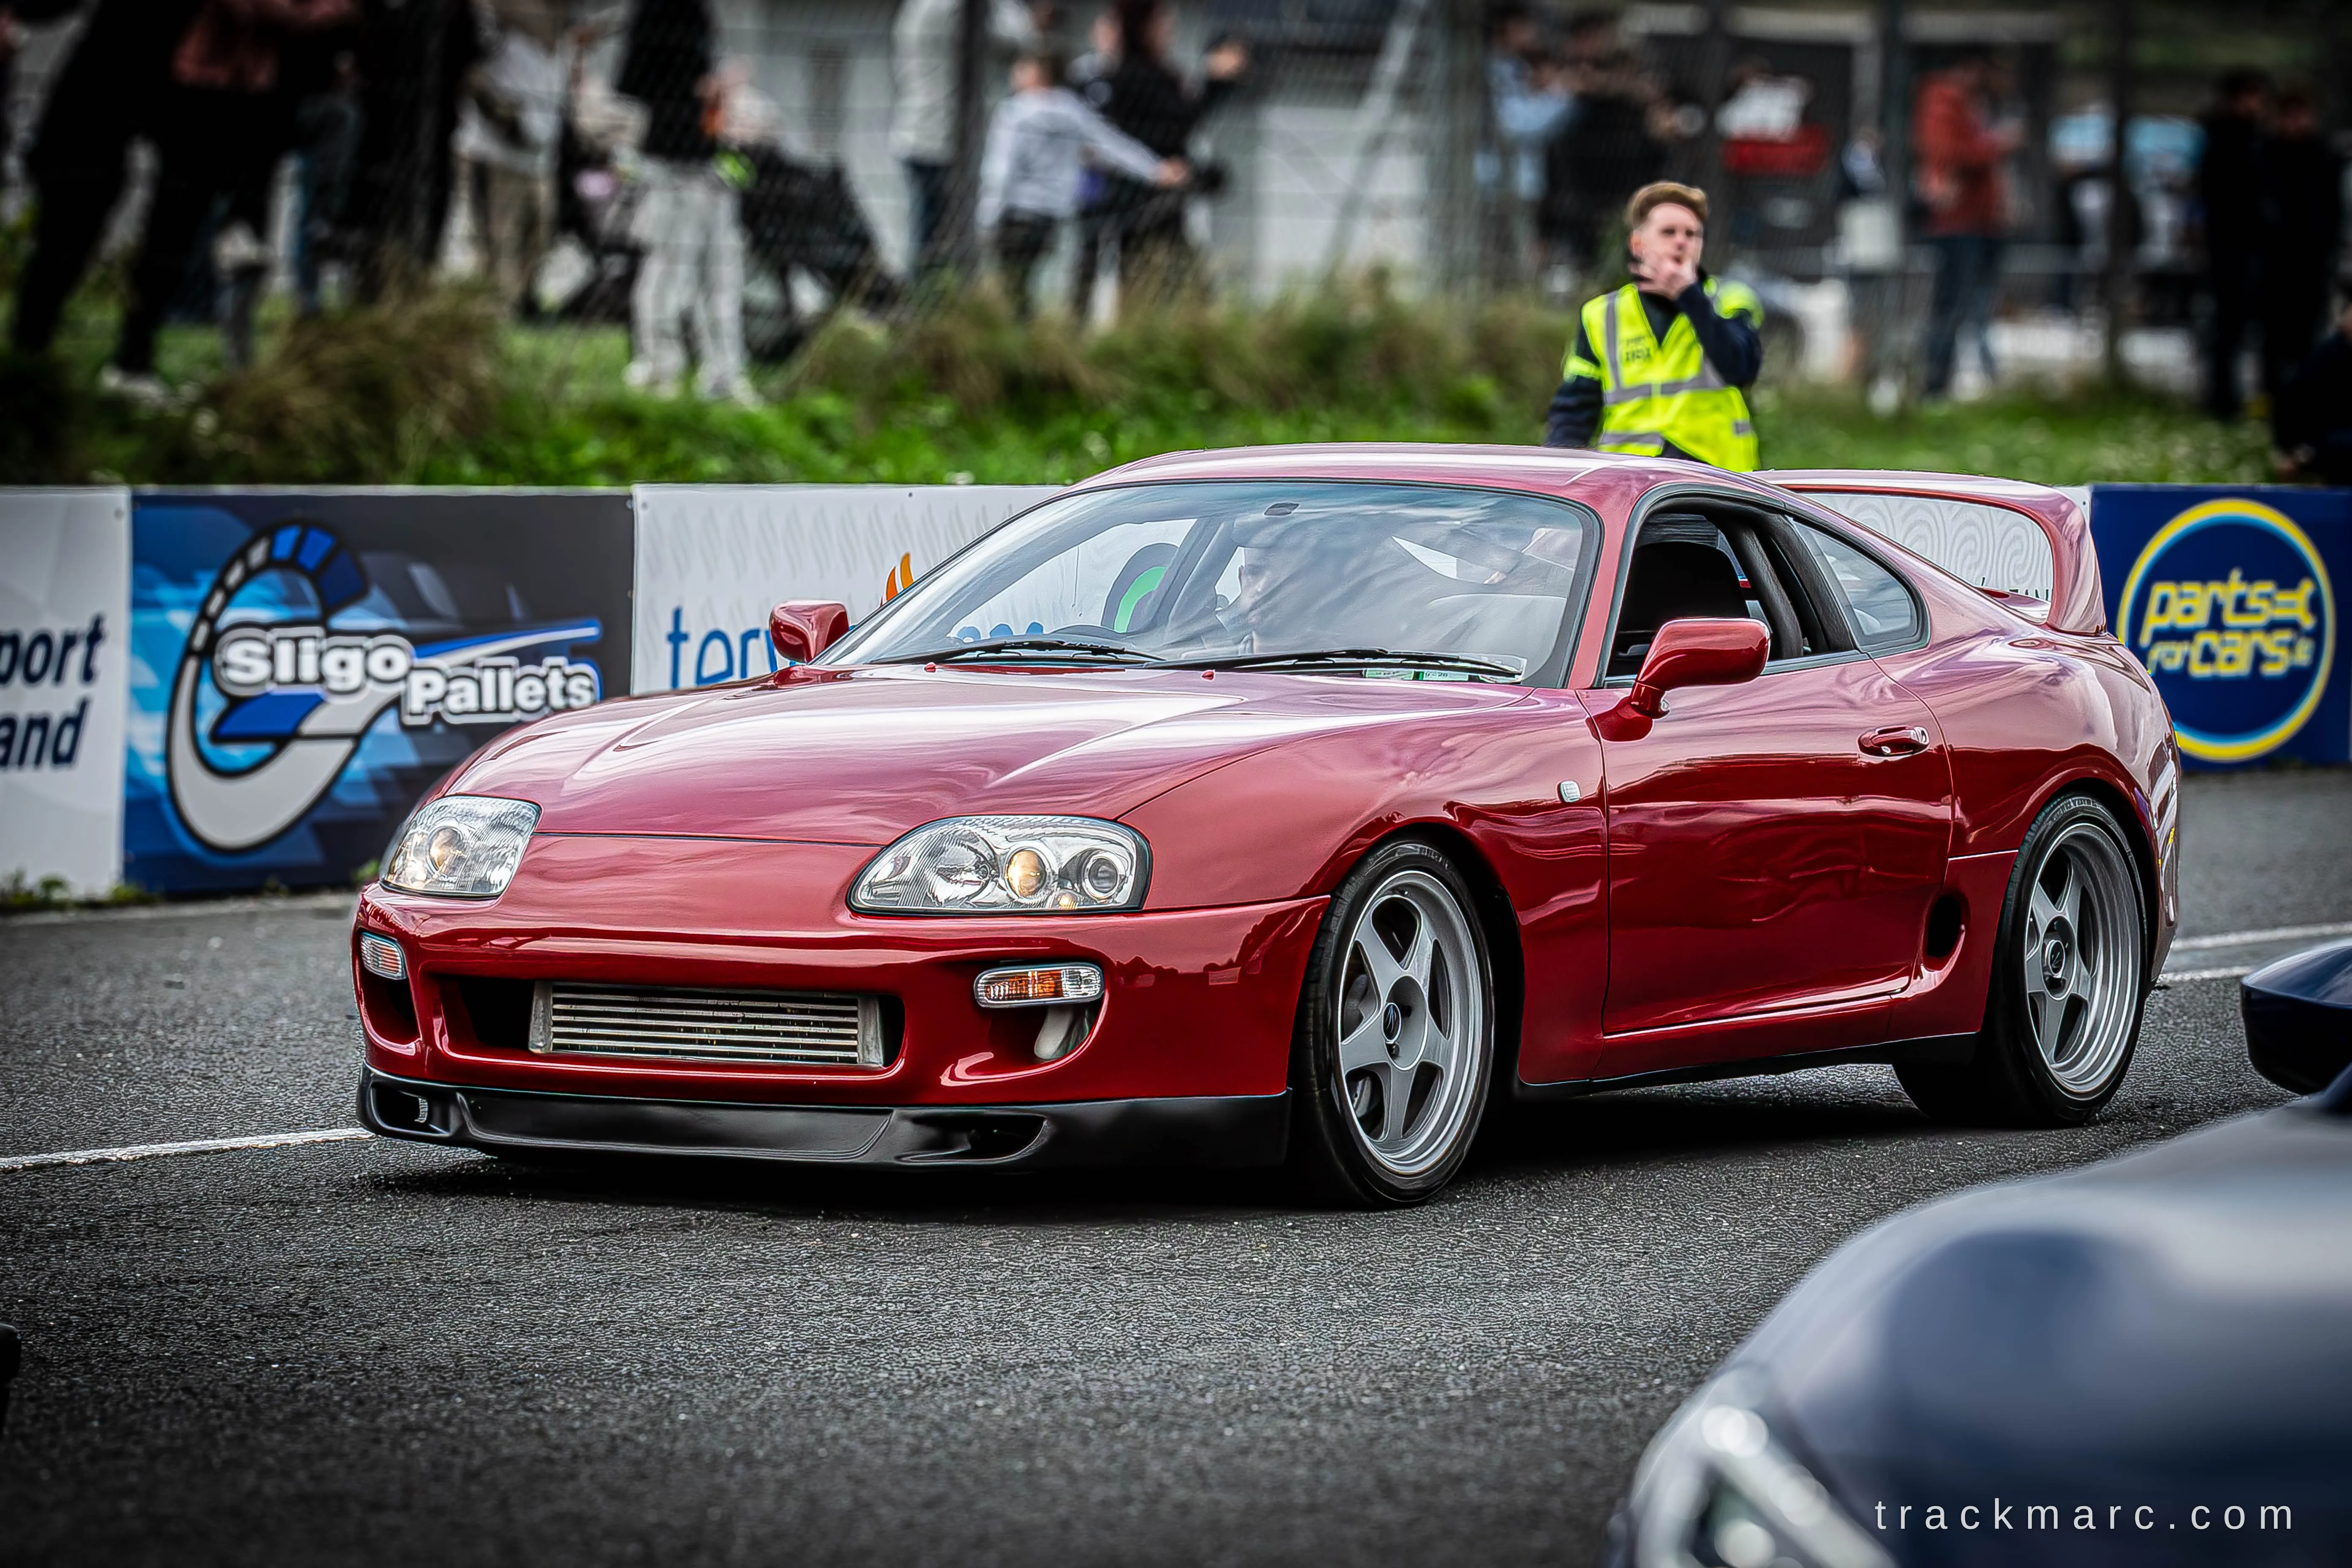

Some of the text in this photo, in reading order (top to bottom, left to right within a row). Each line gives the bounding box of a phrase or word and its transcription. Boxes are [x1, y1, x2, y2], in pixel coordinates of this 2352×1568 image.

[2140, 567, 2276, 646] parts
[222, 637, 594, 715] Sligo Pallets
